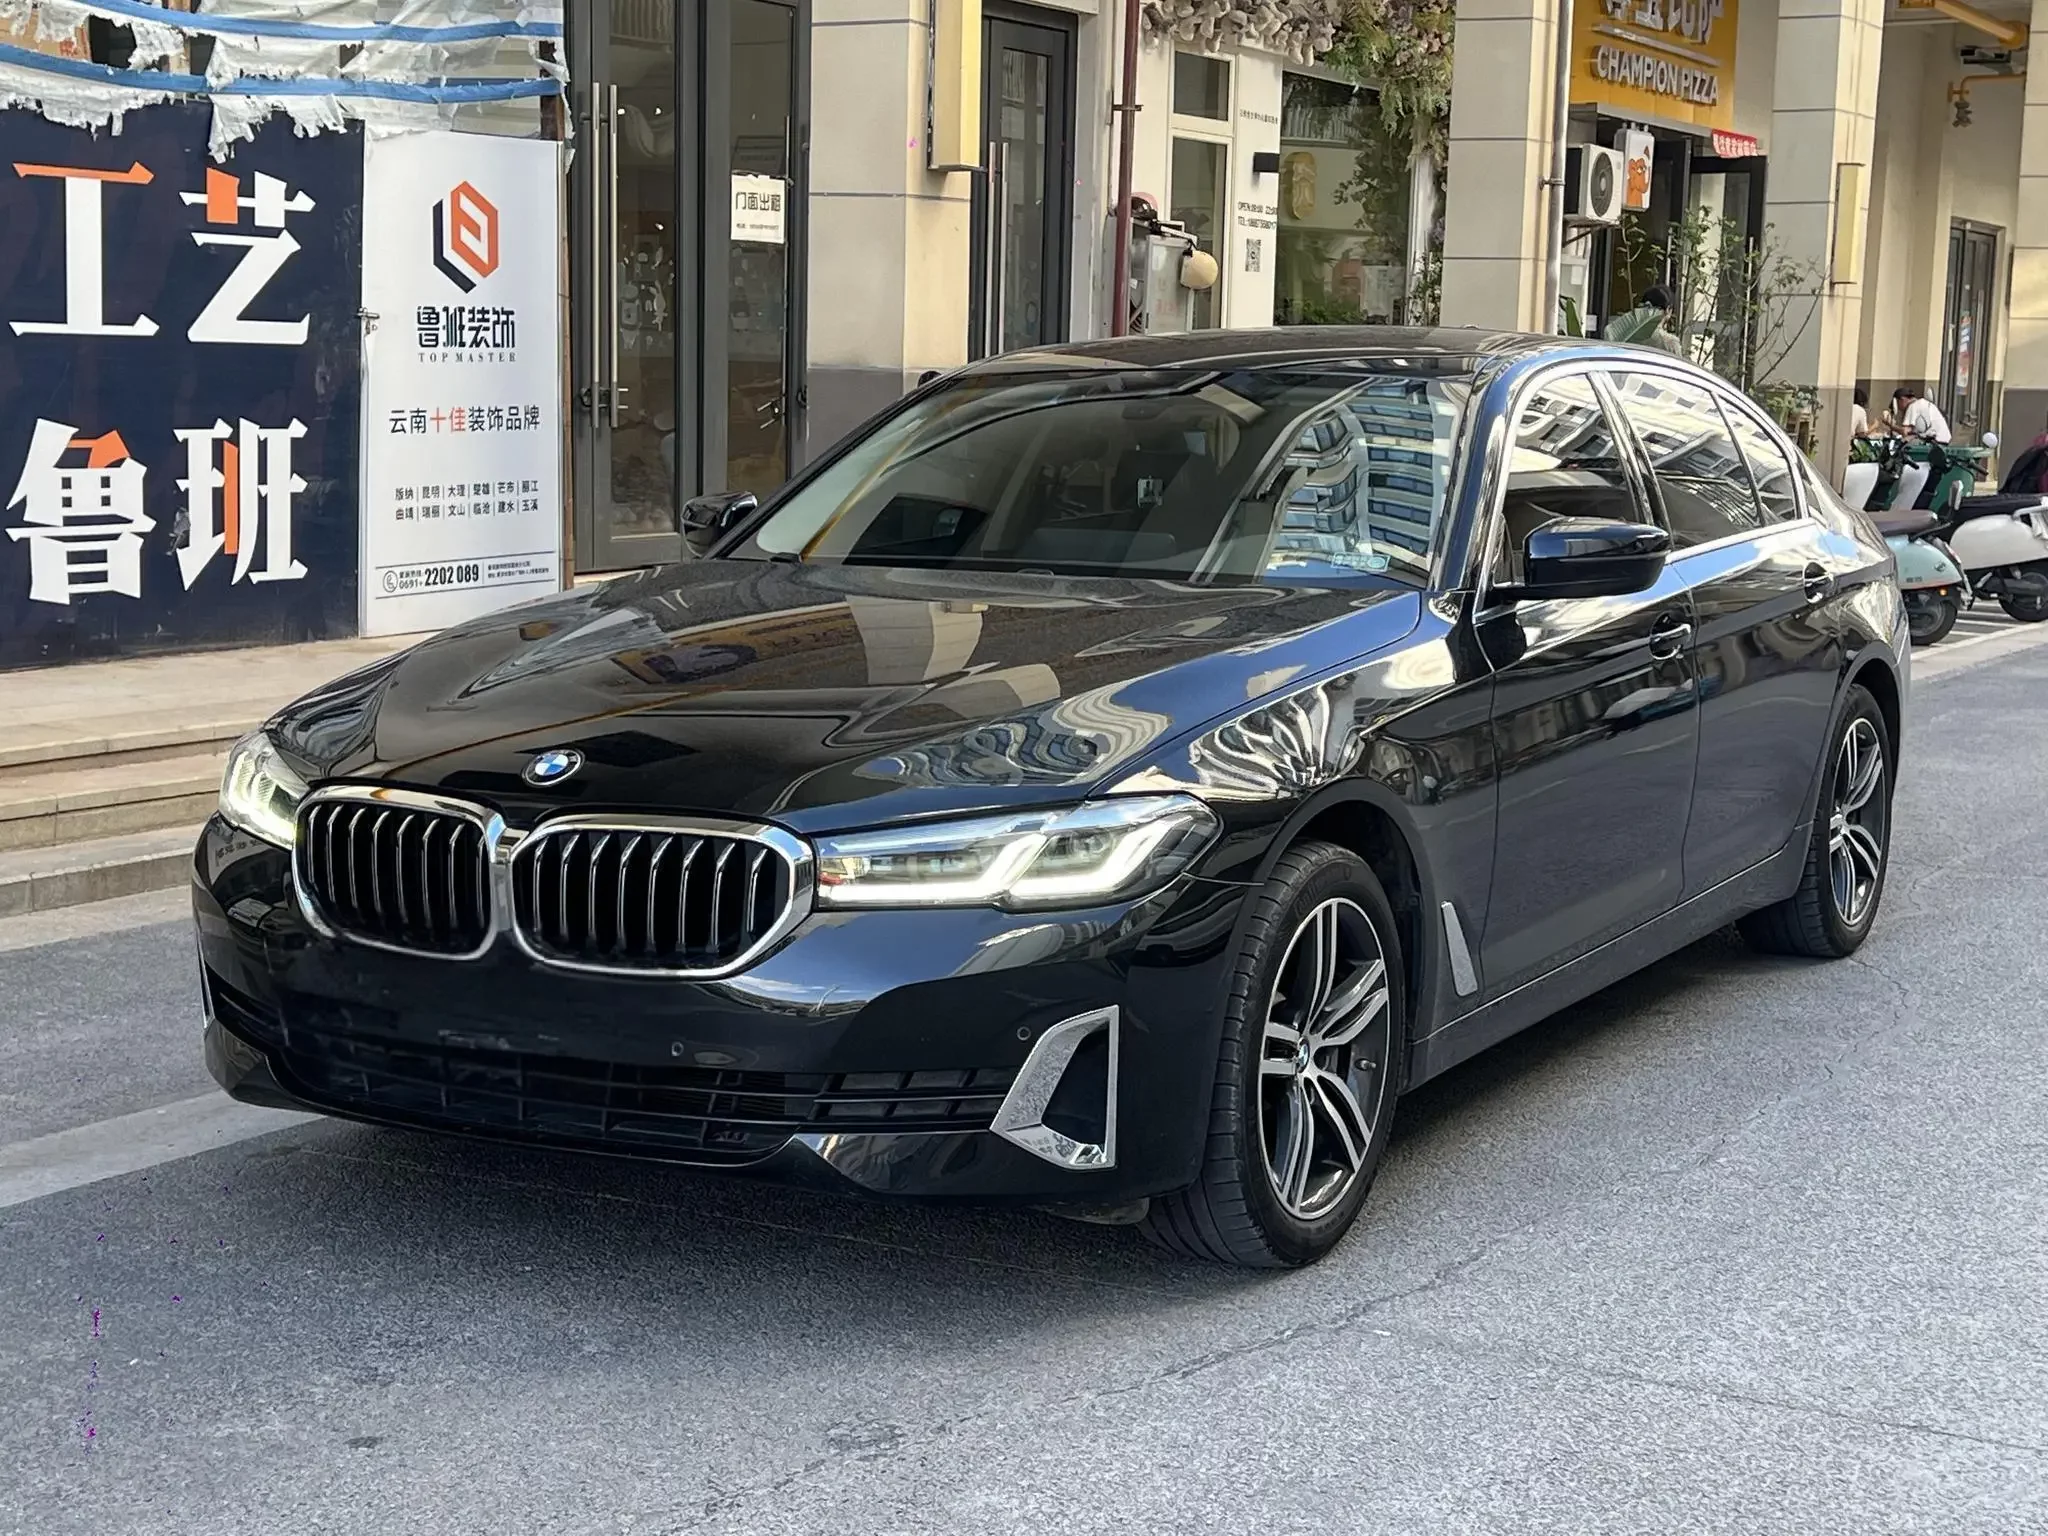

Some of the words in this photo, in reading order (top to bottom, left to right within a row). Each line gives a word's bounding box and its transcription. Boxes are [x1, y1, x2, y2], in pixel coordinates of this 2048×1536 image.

[1594, 44, 1680, 97] CHAMPION
[1680, 67, 1720, 106] PIZZA
[735, 191, 781, 212] 门面出租
[9, 161, 316, 344] 工艺
[416, 305, 516, 348] 鲁班装饰
[418, 352, 448, 363] TOP
[455, 352, 516, 363] MASTER
[388, 404, 541, 435] 云南十佳装饰品牌
[447, 484, 466, 498] 大理
[5, 417, 309, 605] 鲁班
[447, 503, 466, 517] 文山
[424, 565, 454, 587] 2202
[456, 563, 480, 583] 089
